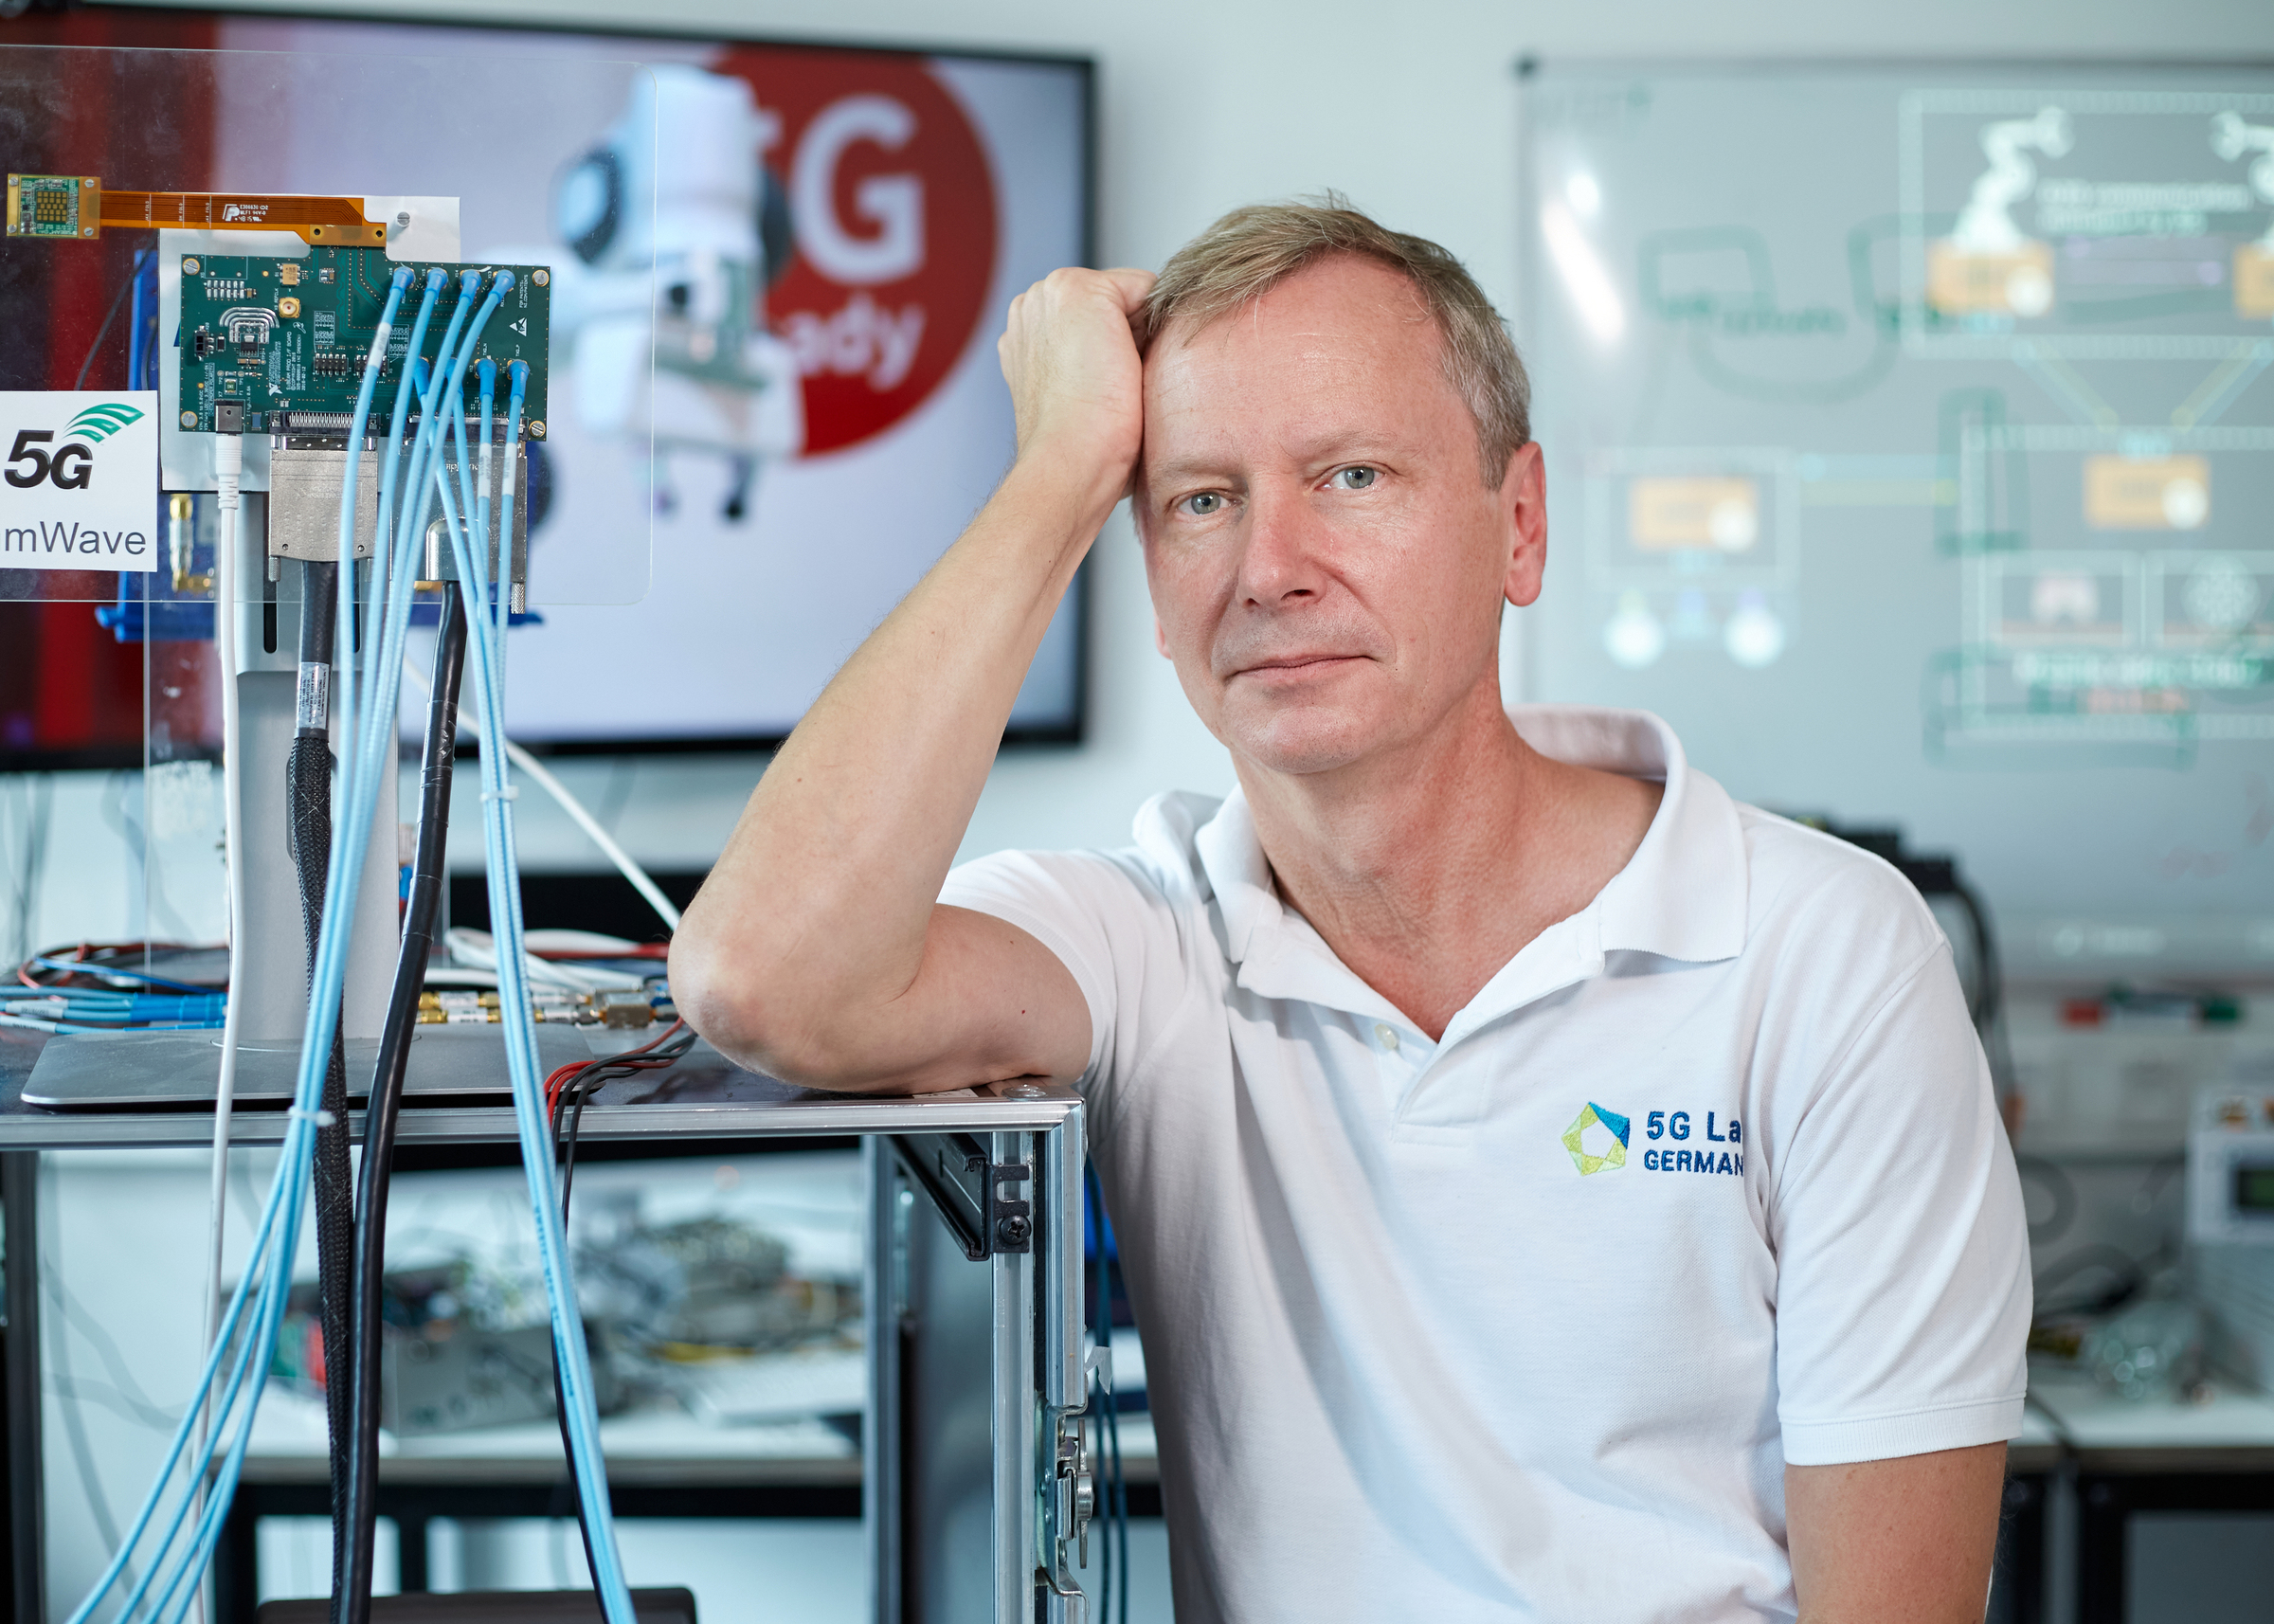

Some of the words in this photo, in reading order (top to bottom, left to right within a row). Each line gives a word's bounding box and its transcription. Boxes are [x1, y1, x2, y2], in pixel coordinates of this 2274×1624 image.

[786, 294, 926, 390] ady
[5, 430, 93, 490] 5G
[5, 521, 146, 554] mWave
[1646, 1110, 1691, 1141] 5G
